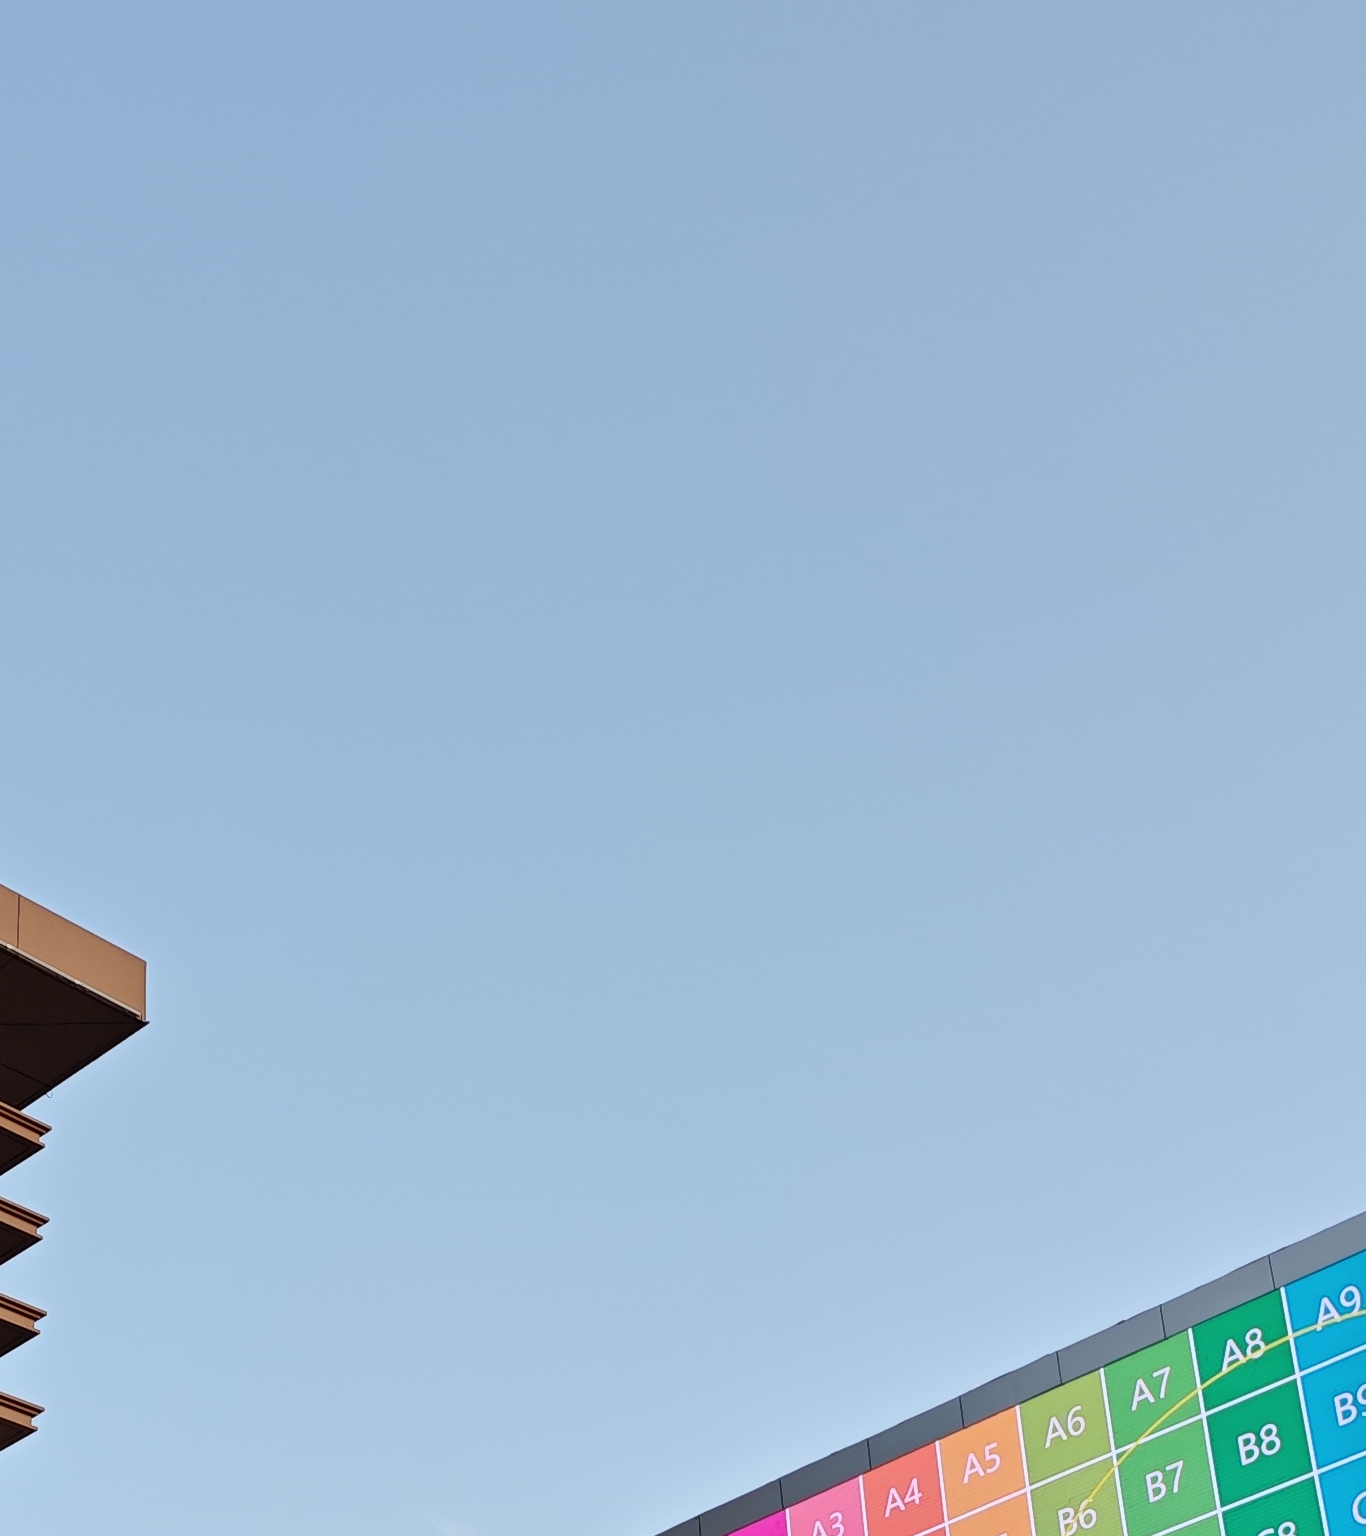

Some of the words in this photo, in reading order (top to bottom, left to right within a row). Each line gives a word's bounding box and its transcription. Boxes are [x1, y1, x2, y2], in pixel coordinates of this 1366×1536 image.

[883, 1476, 923, 1518] A4
[962, 1441, 1001, 1484] A5
[1044, 1404, 1086, 1449] A6
[1130, 1365, 1171, 1411] A7
[1220, 1326, 1265, 1370] A8
[1316, 1284, 1361, 1333] A9
[1144, 1459, 1184, 1503] B7
[1236, 1422, 1281, 1466] B8
